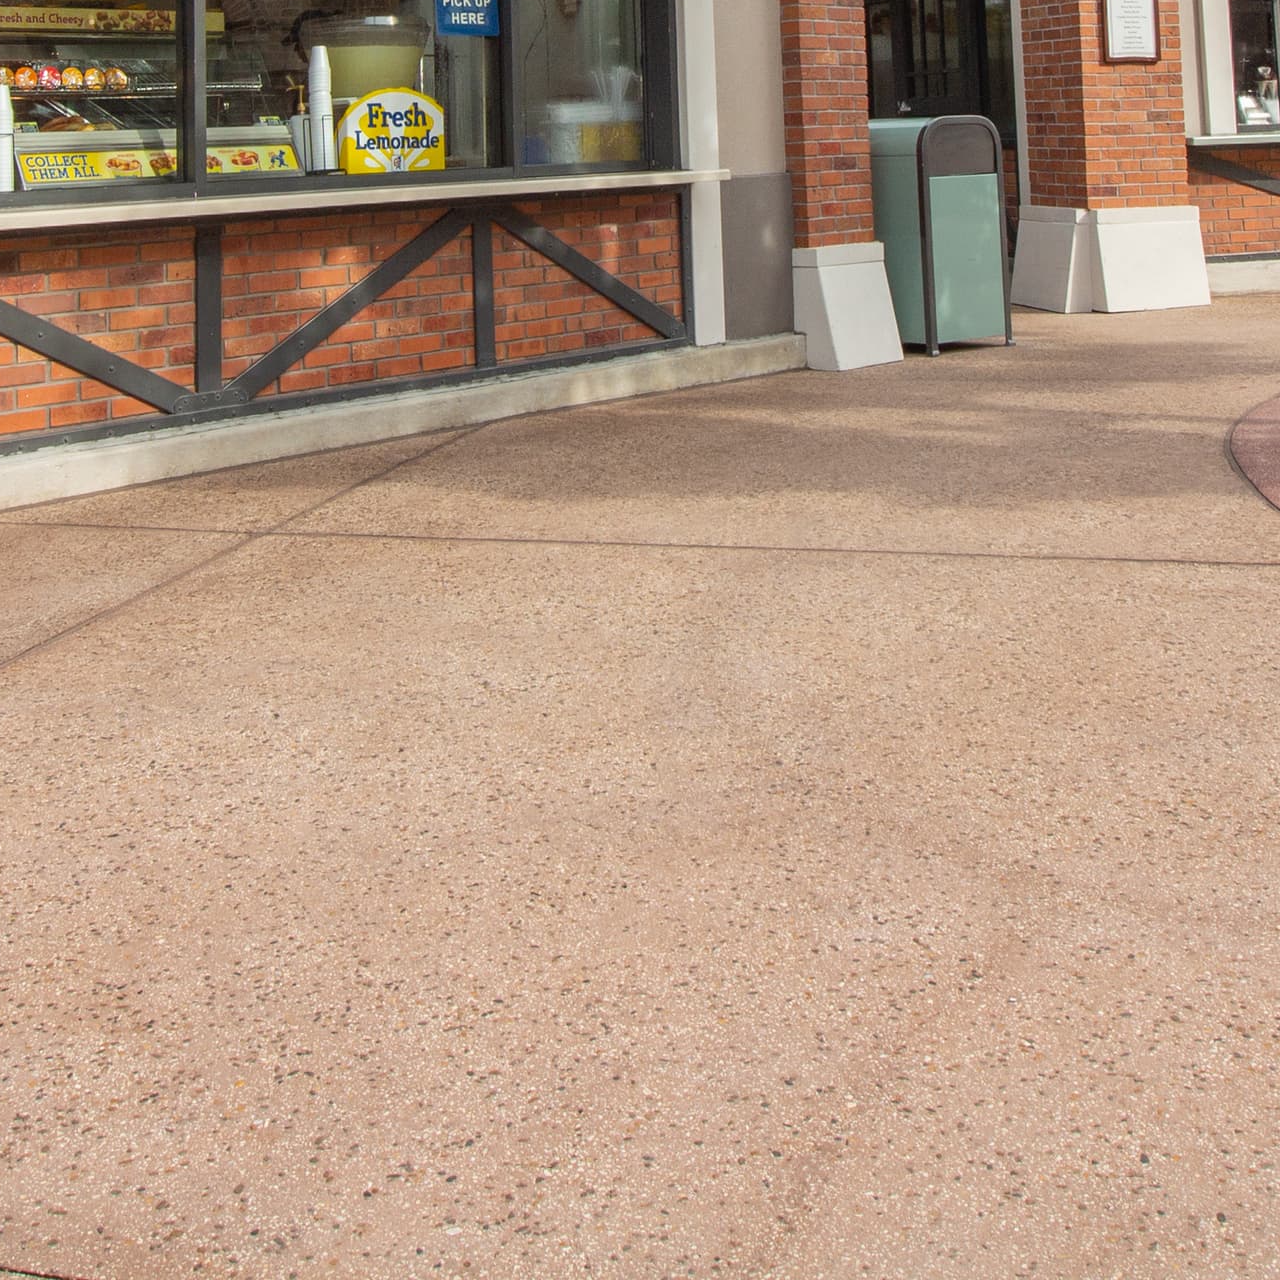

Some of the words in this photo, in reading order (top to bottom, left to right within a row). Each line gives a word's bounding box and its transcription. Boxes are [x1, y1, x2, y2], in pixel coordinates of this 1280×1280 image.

[25, 13, 46, 24] and
[48, 14, 84, 27] Cheesy
[451, 12, 486, 25] HERE
[367, 102, 427, 128] Fresh
[354, 129, 440, 150] Lemonade
[25, 155, 88, 168] COLLECT
[28, 167, 69, 180] THEM
